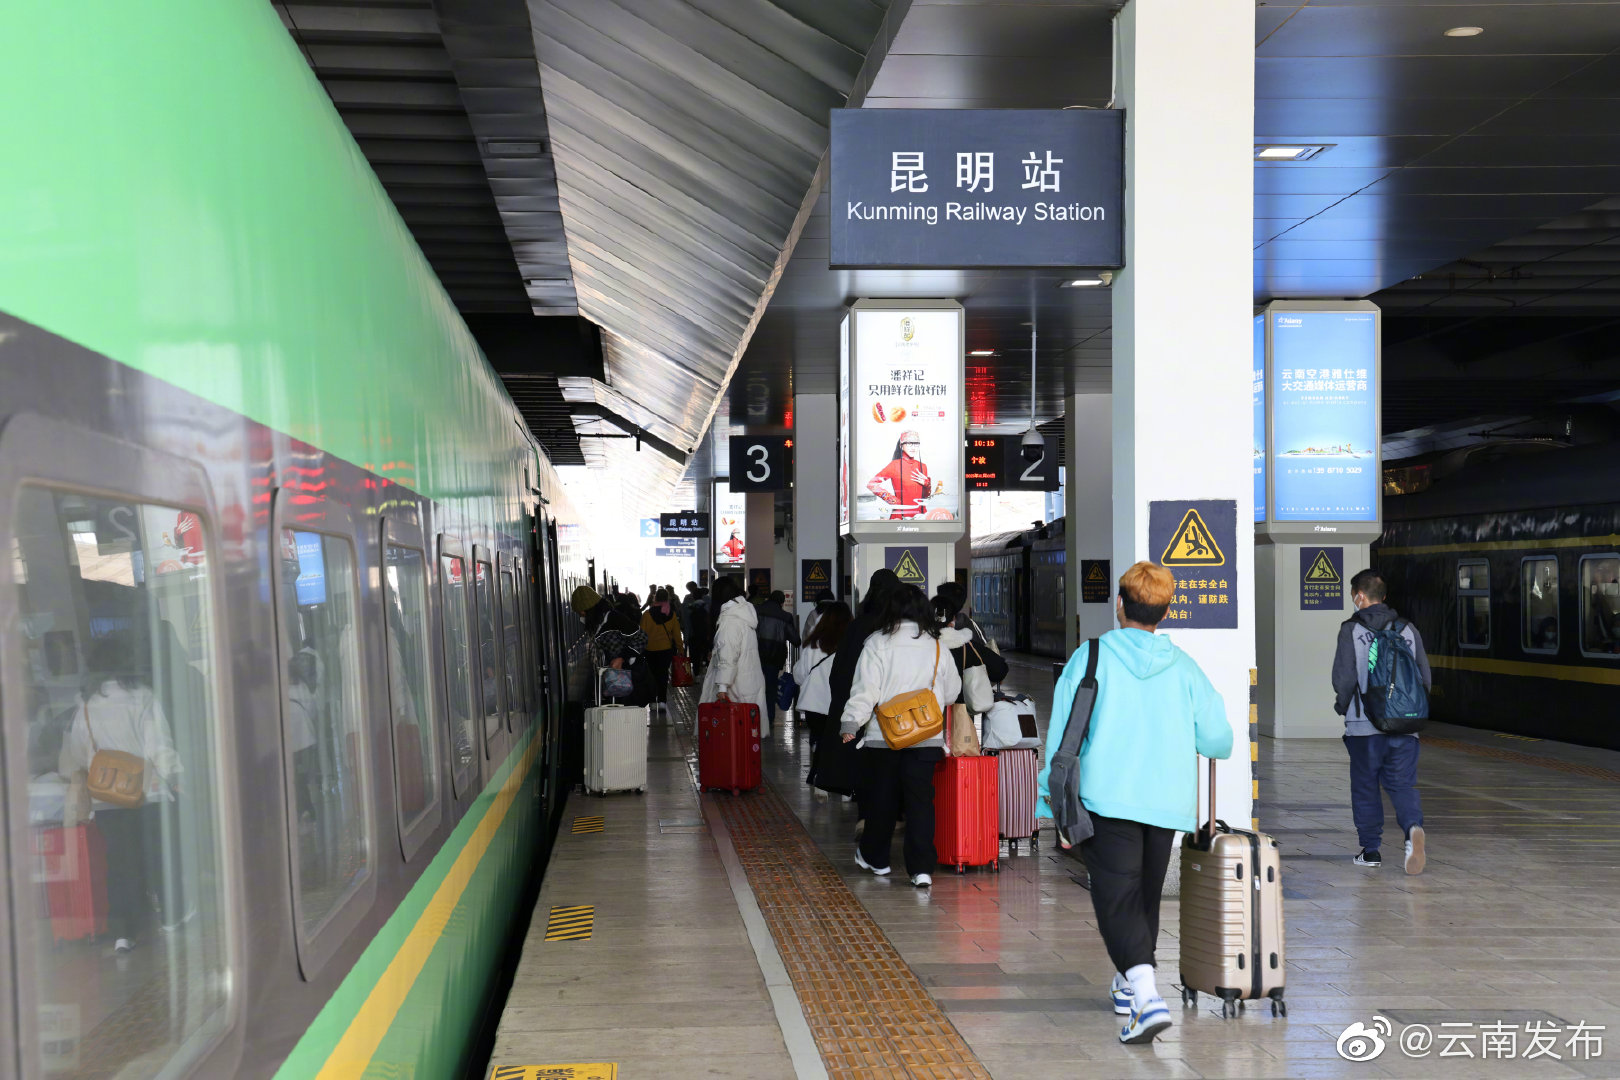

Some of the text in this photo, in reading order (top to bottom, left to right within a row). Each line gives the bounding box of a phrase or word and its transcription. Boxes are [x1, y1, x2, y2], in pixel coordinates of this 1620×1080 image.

[890, 150, 1064, 193] 昆明站
[847, 201, 1105, 225] Kunming Railway Station
[890, 369, 925, 381] 潘祥记
[1281, 369, 1368, 380] 云南空港雅仕维
[868, 384, 947, 396] 只用鲜花做好饼
[1281, 380, 1368, 391] 大交通媒体运营商
[974, 439, 995, 447] 10:15
[746, 444, 771, 483] 3
[1019, 449, 1045, 482] 2
[645, 520, 656, 536] 3
[669, 518, 699, 527] 昆明站
[1164, 610, 1192, 620] 站台！
